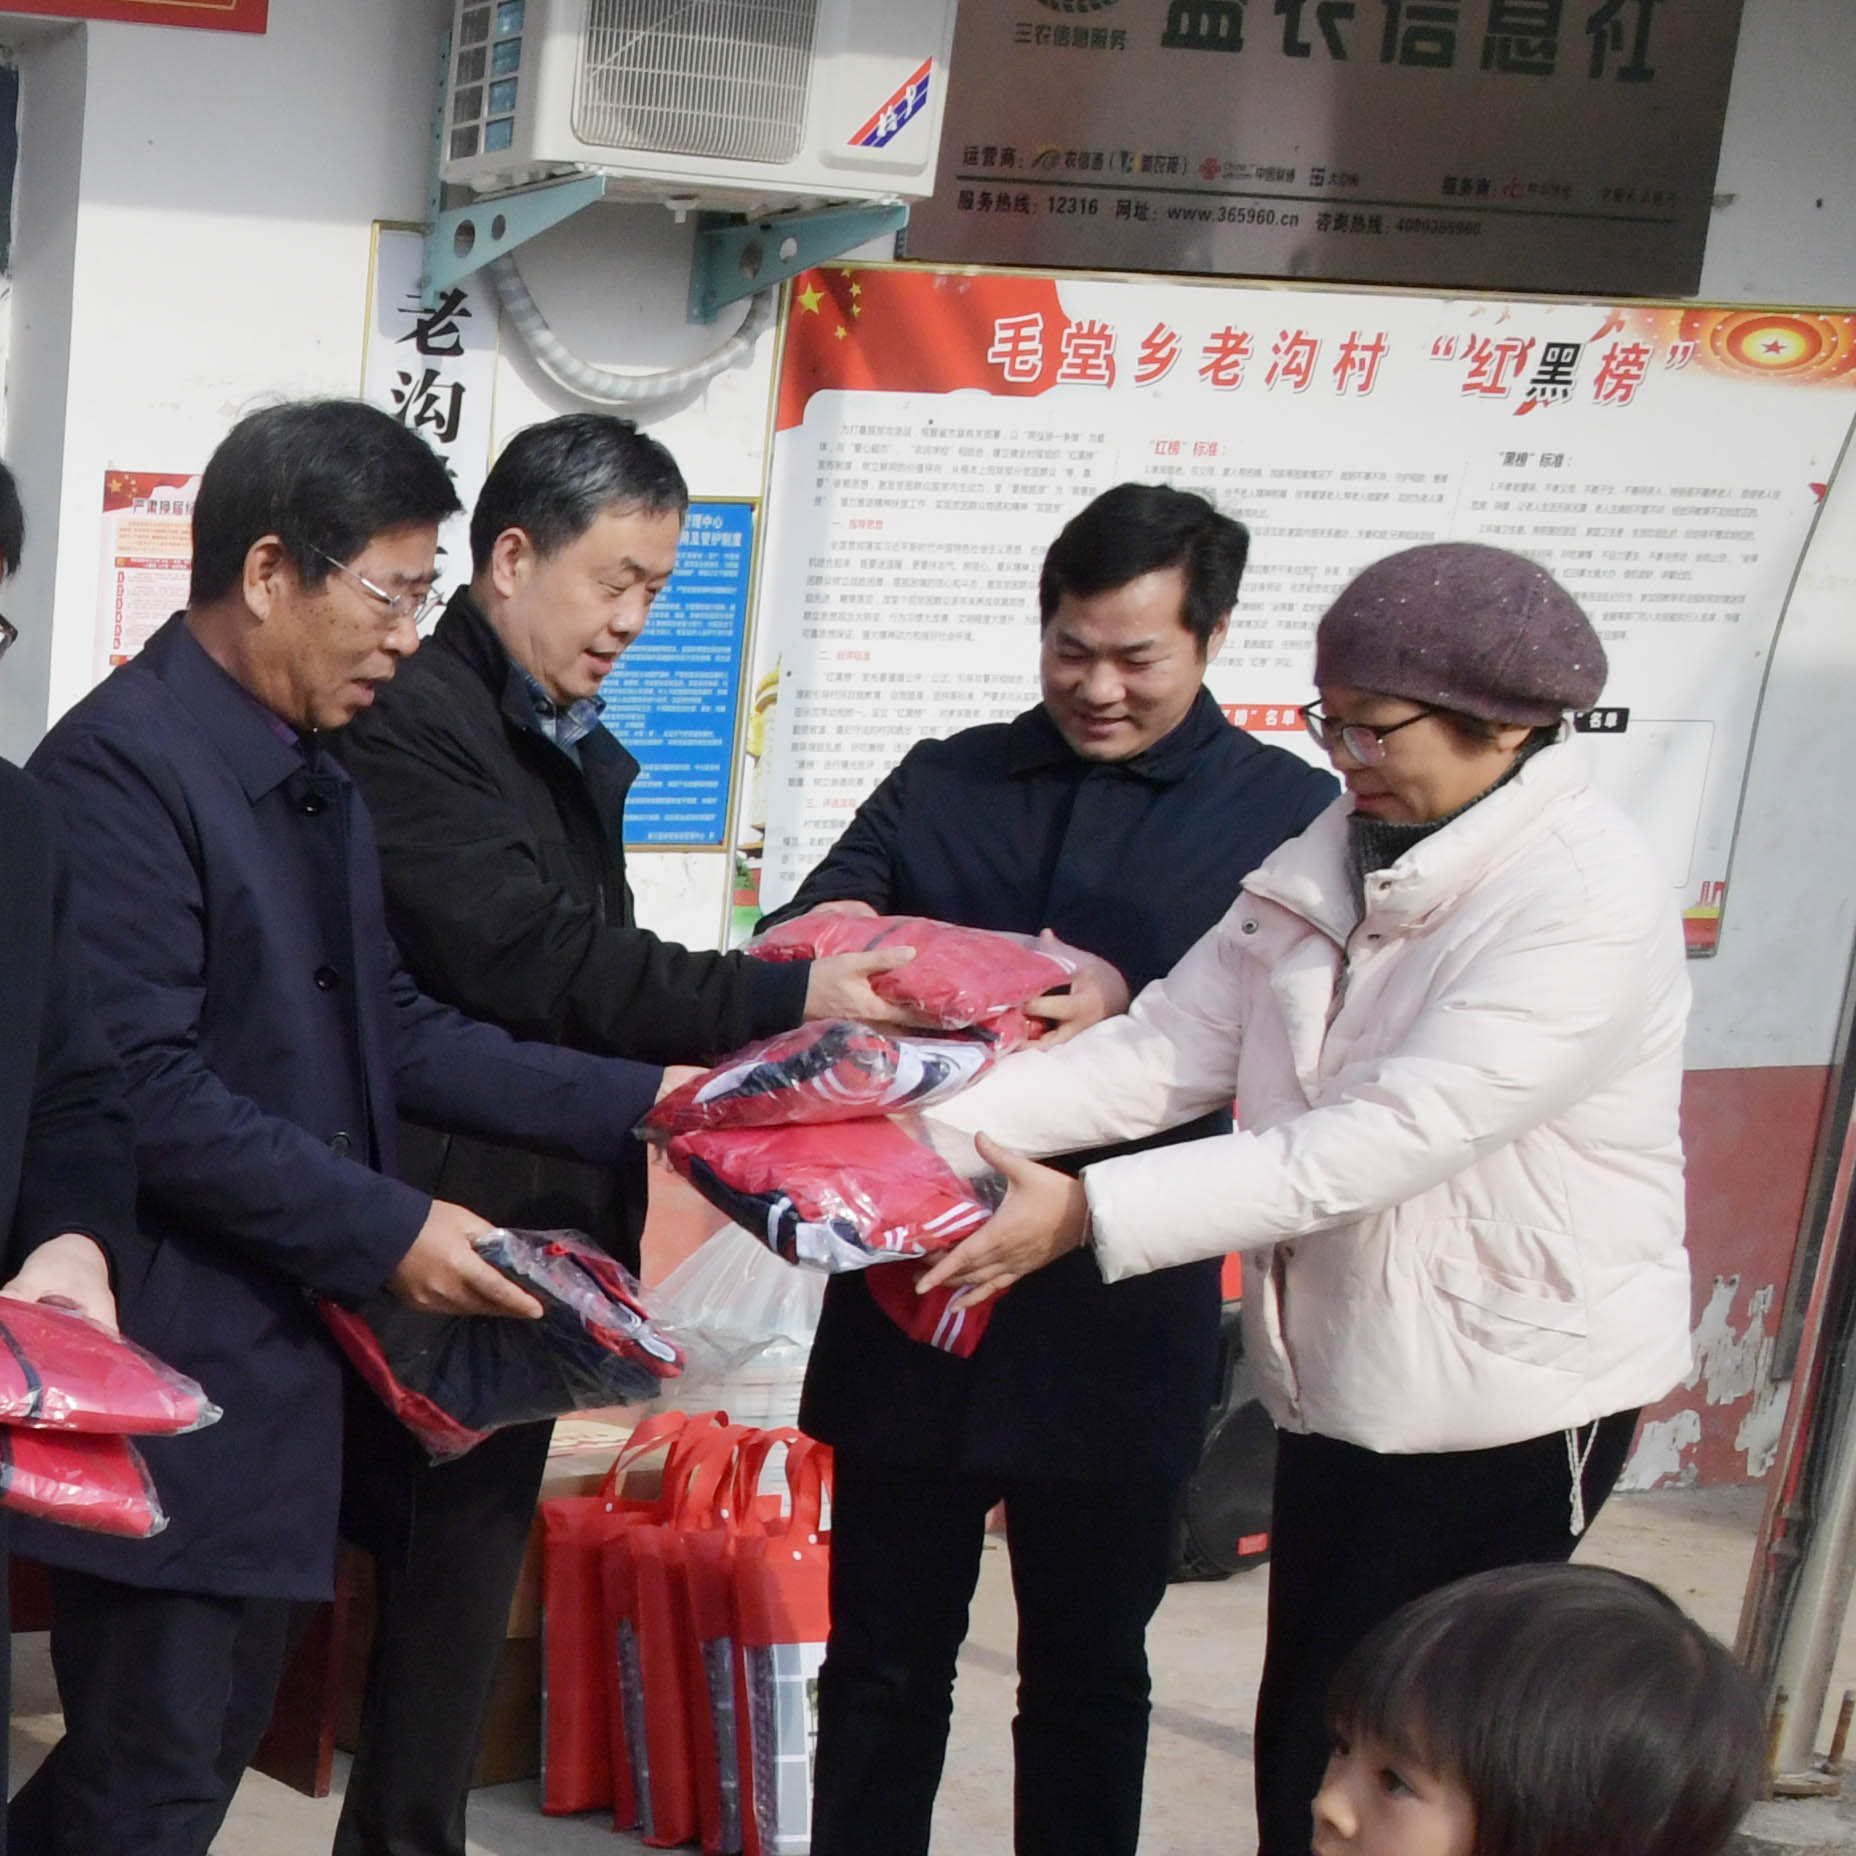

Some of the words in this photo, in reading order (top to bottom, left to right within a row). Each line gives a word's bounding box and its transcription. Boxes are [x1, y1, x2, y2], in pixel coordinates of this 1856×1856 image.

[956, 190, 1039, 216] 服务热线：
[1047, 196, 1099, 216] 12316
[1166, 206, 1300, 227] www.365960.cn
[391, 288, 472, 480] 老沟
[987, 320, 1390, 394] 毛堂乡老沟村
[1429, 338, 1695, 405] “红黑榜”
